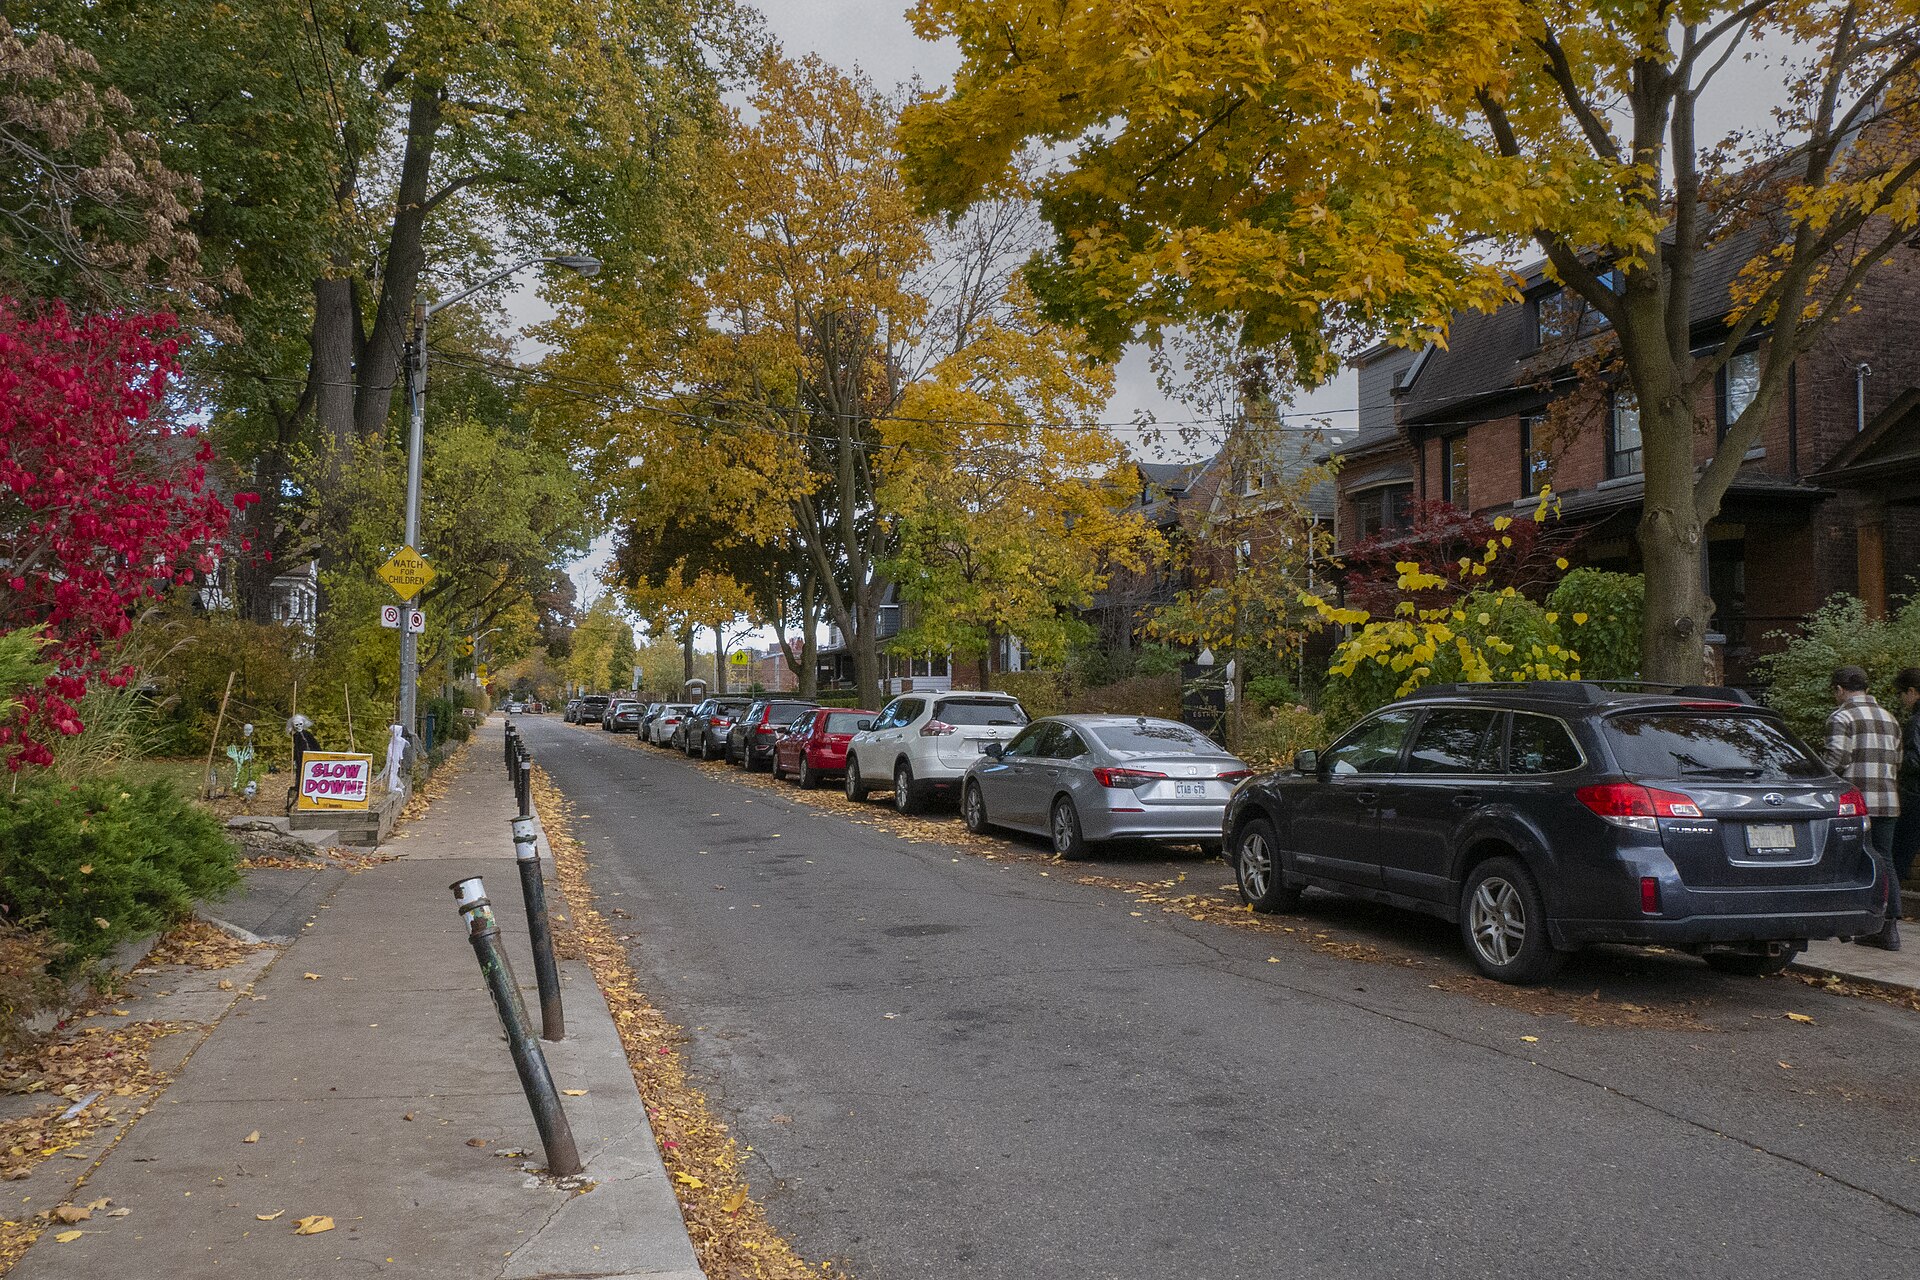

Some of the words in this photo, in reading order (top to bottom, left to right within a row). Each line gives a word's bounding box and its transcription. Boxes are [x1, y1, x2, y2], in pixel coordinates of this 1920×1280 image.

[393, 559, 423, 569] WATCH
[400, 568, 415, 576] FOR
[388, 575, 425, 585] CHILDREN
[311, 763, 362, 779] SLOW
[304, 779, 364, 795] DOWN!
[1668, 826, 1713, 835] SUBARU
